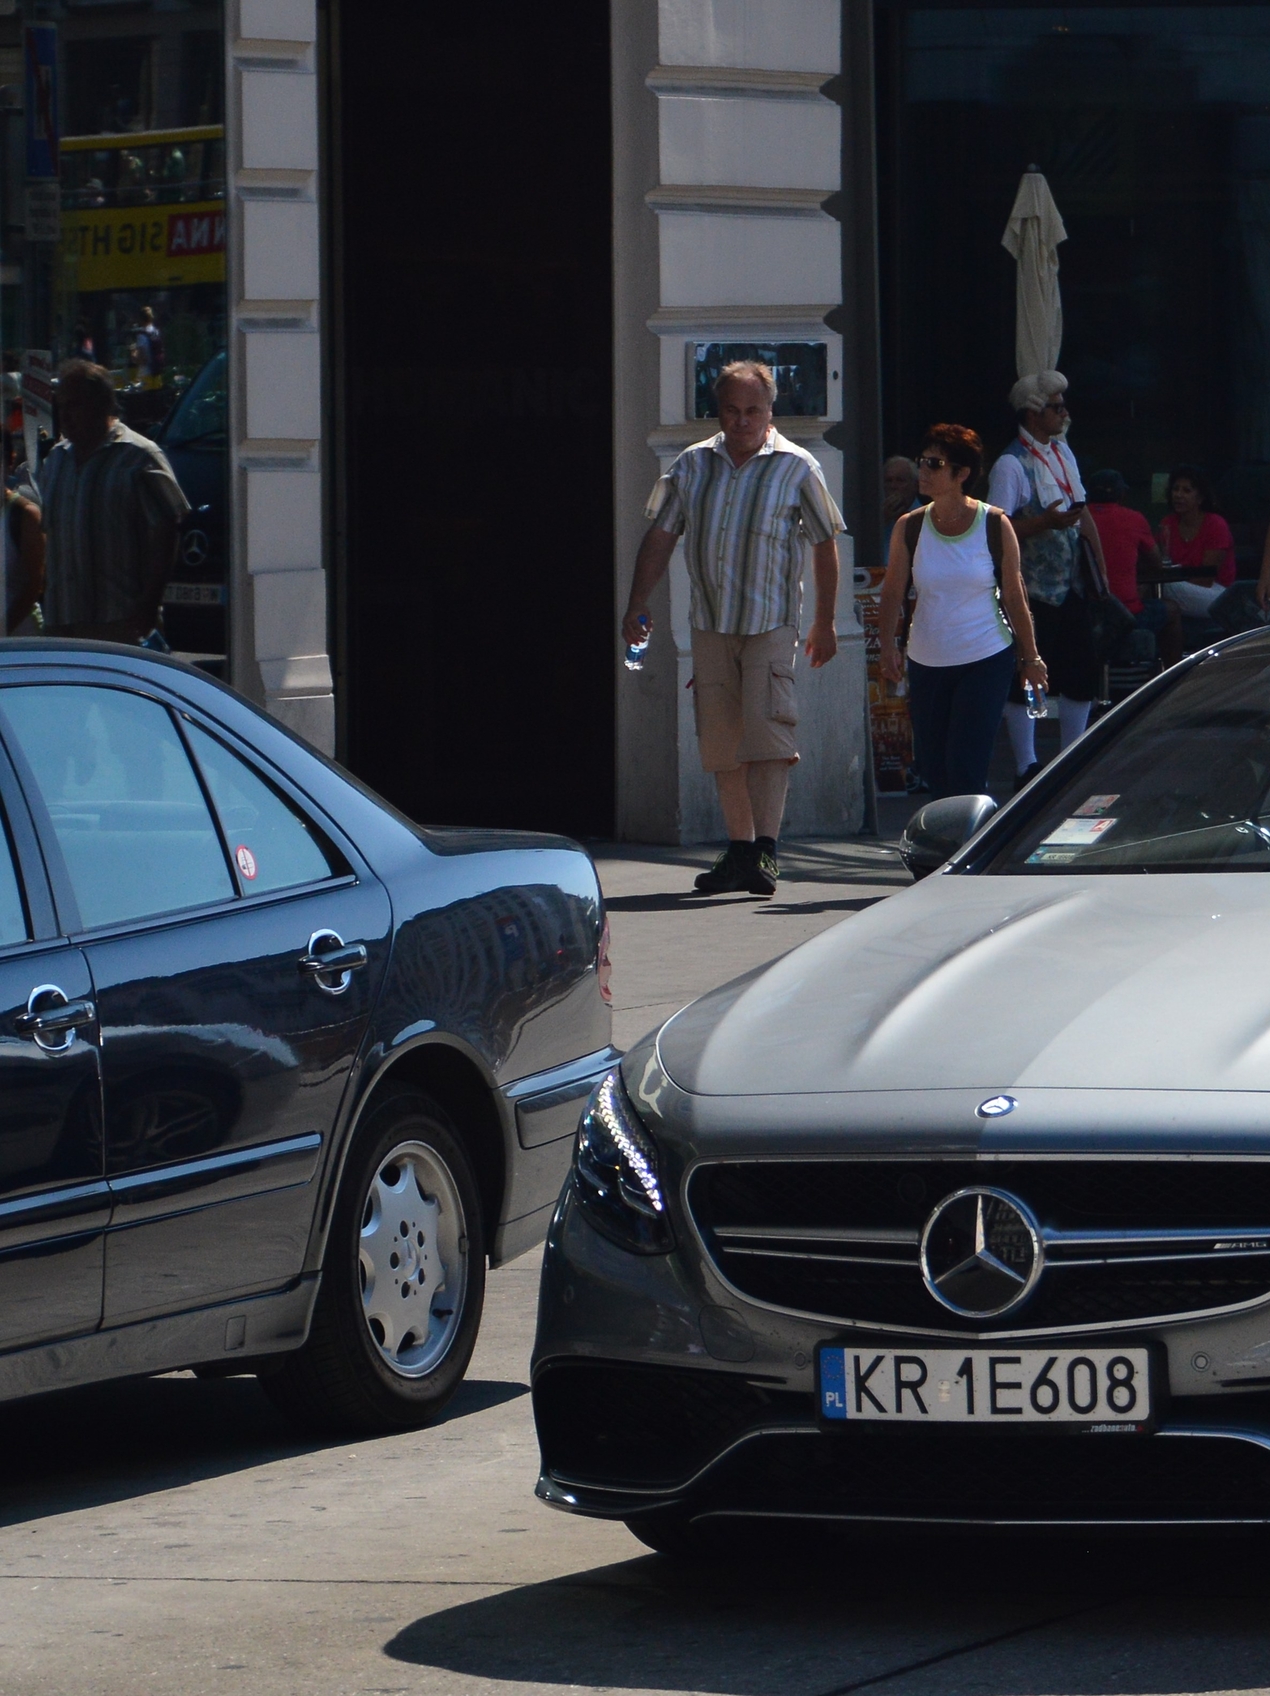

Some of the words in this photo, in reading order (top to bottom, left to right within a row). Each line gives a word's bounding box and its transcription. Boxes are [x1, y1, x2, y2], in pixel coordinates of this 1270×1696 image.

[825, 1391, 843, 1408] PL
[853, 1355, 929, 1414] KR
[957, 1355, 1137, 1414] 1E608
